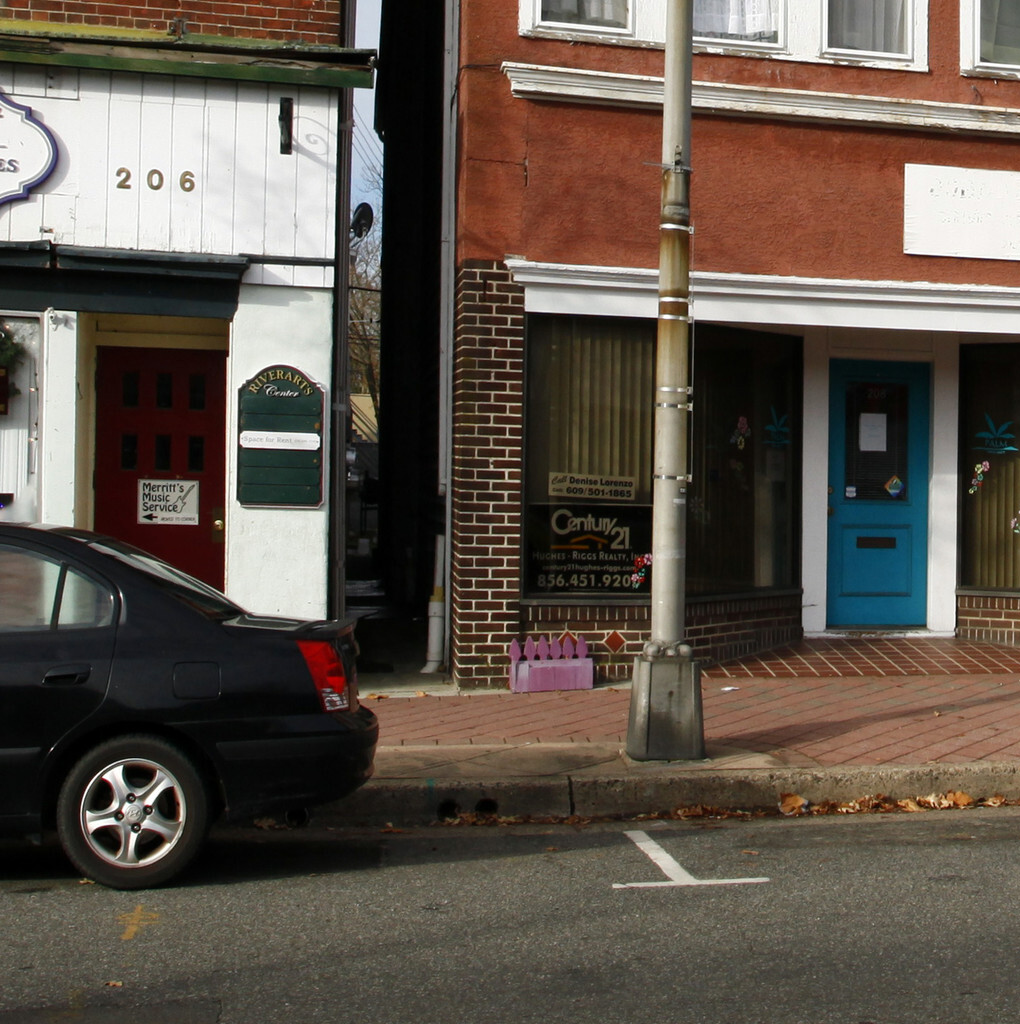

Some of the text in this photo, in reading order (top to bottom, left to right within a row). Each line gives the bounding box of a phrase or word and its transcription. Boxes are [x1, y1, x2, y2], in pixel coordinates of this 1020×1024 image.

[115, 166, 196, 192] 206
[248, 369, 314, 396] RIVERARTS
[263, 383, 300, 397] Center
[243, 436, 264, 444] Space
[276, 436, 293, 444] Rent
[142, 482, 185, 493] Merritt's
[569, 476, 598, 486] Denise
[600, 478, 634, 488] Lorenzo
[142, 492, 171, 503] Music
[566, 486, 632, 498] 609/501-1865
[142, 501, 179, 513] Service
[551, 508, 618, 536] Century
[610, 526, 630, 550] 21
[599, 551, 630, 563] REALTY,
[536, 574, 637, 588] 856.451.920
